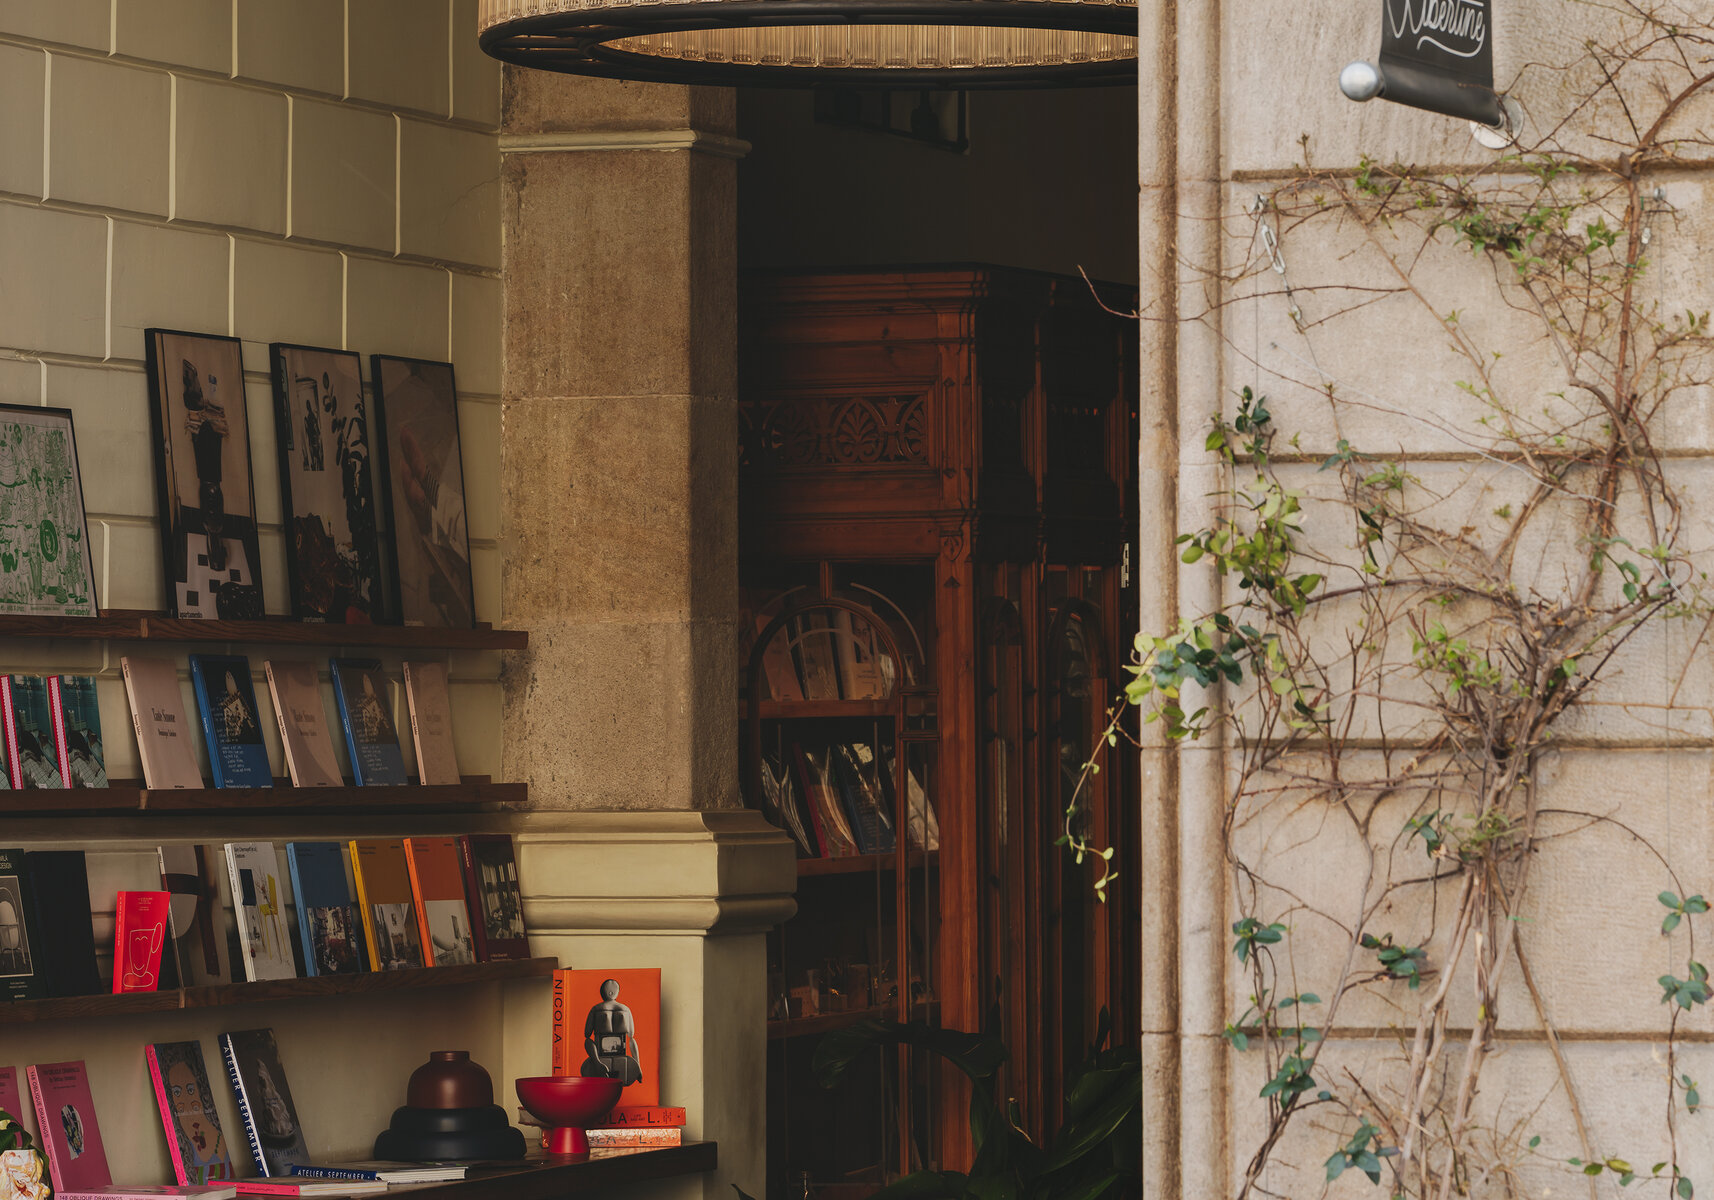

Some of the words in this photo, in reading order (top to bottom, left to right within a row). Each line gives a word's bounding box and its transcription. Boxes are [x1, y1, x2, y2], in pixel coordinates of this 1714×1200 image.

[554, 979, 563, 1044] NICOLA
[32, 1081, 42, 1107] OBLIQUE
[38, 1108, 49, 1139] DRAWINGS
[223, 1046, 241, 1091] ATELIER
[238, 1099, 262, 1161] SEPTEMBER
[297, 1169, 324, 1178] ATELIER
[327, 1171, 365, 1180] SEPTEMBER
